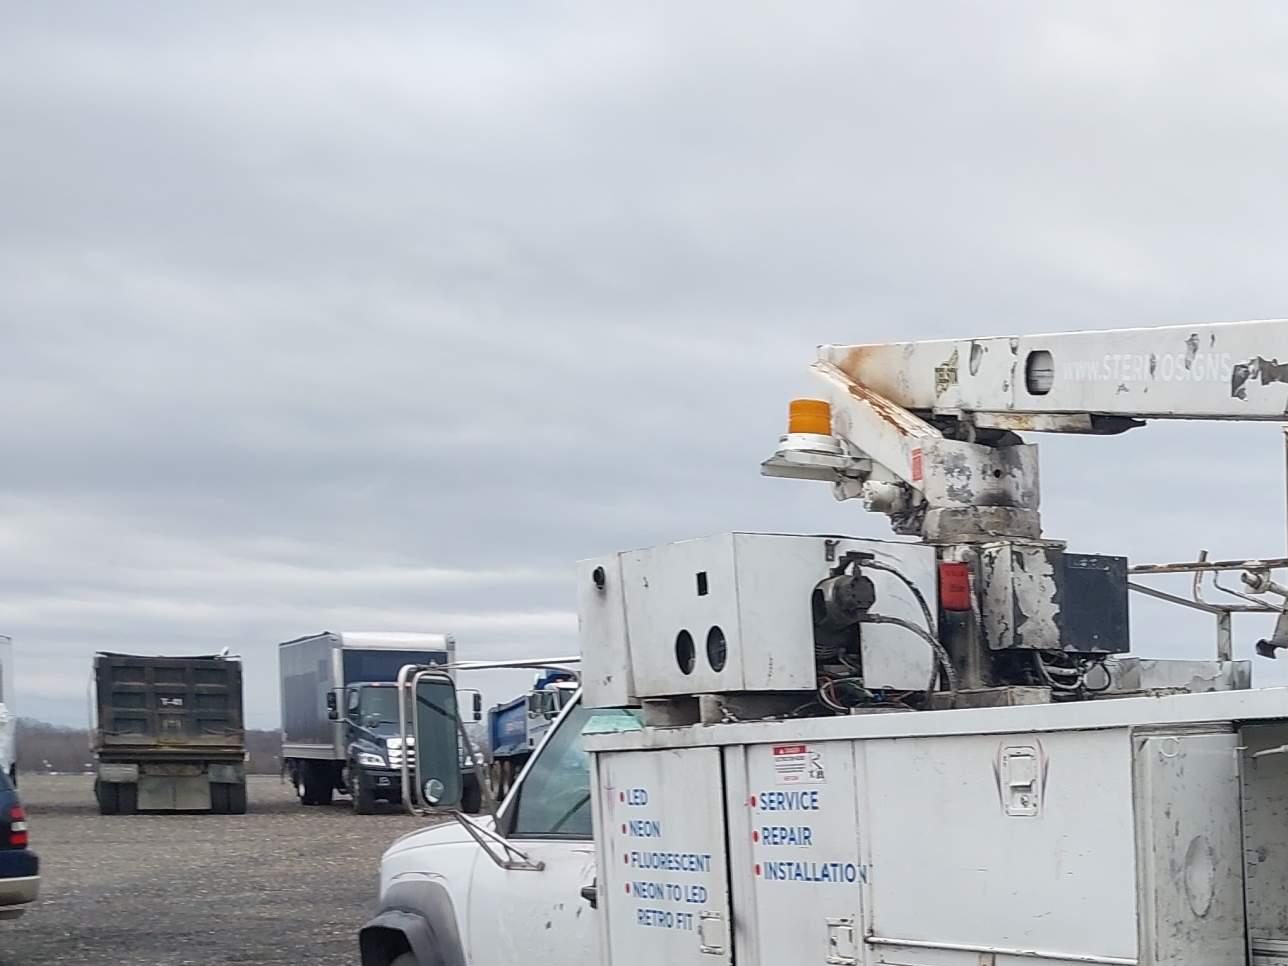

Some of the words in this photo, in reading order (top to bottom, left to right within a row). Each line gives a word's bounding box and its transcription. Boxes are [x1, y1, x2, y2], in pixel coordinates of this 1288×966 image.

[627, 788, 648, 806] LED
[760, 791, 819, 811] SERVICE
[629, 820, 661, 838] NEON
[762, 826, 812, 846] REPAIR
[631, 851, 711, 872] FLUORESCENT
[764, 861, 868, 884] INSTALLATION
[632, 881, 664, 900] NEON
[666, 883, 682, 902] TO
[684, 885, 708, 904] LED
[637, 908, 674, 928] RETRO
[676, 912, 693, 931] FIT
